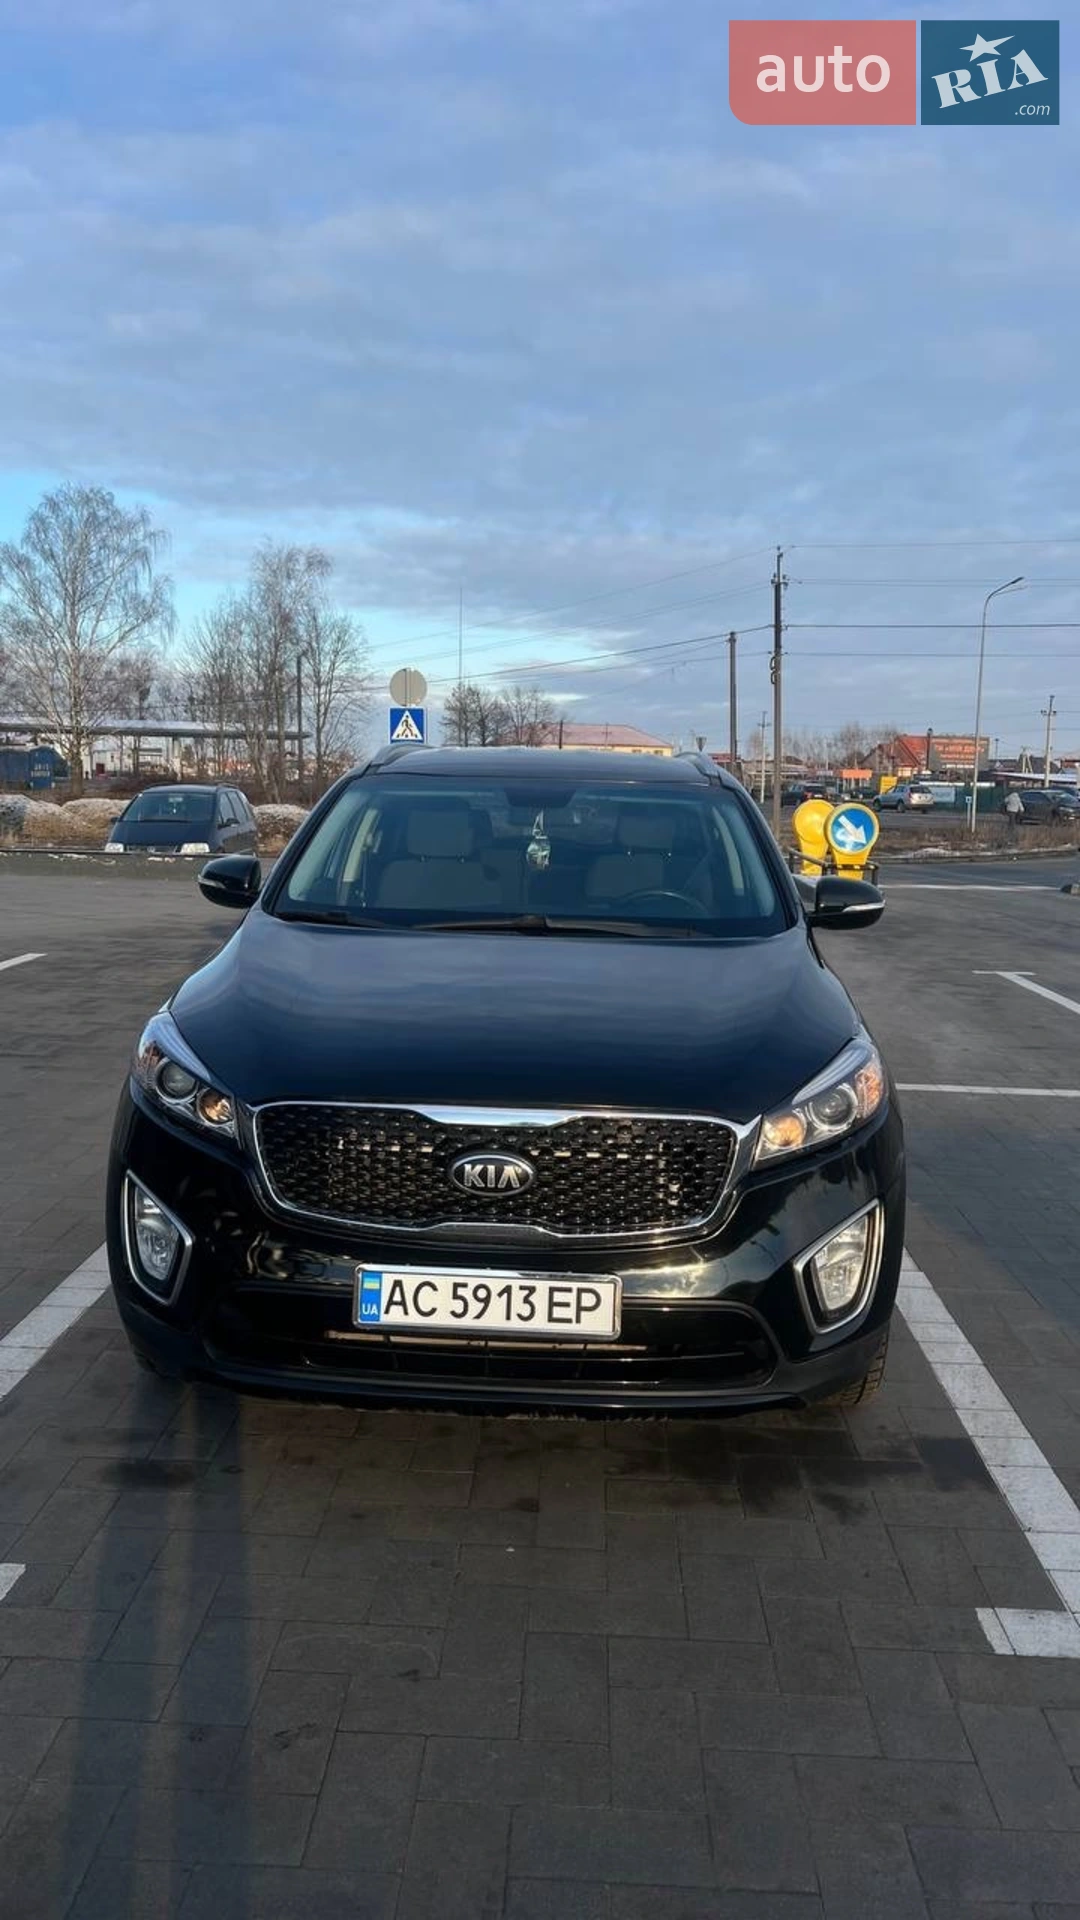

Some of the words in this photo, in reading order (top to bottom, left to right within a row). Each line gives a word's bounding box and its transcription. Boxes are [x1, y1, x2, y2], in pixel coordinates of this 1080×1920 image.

[464, 1163, 520, 1188] KIA
[362, 1303, 379, 1315] UA
[384, 1279, 438, 1317] AC
[450, 1282, 536, 1322] 5913
[548, 1286, 601, 1324] EP
